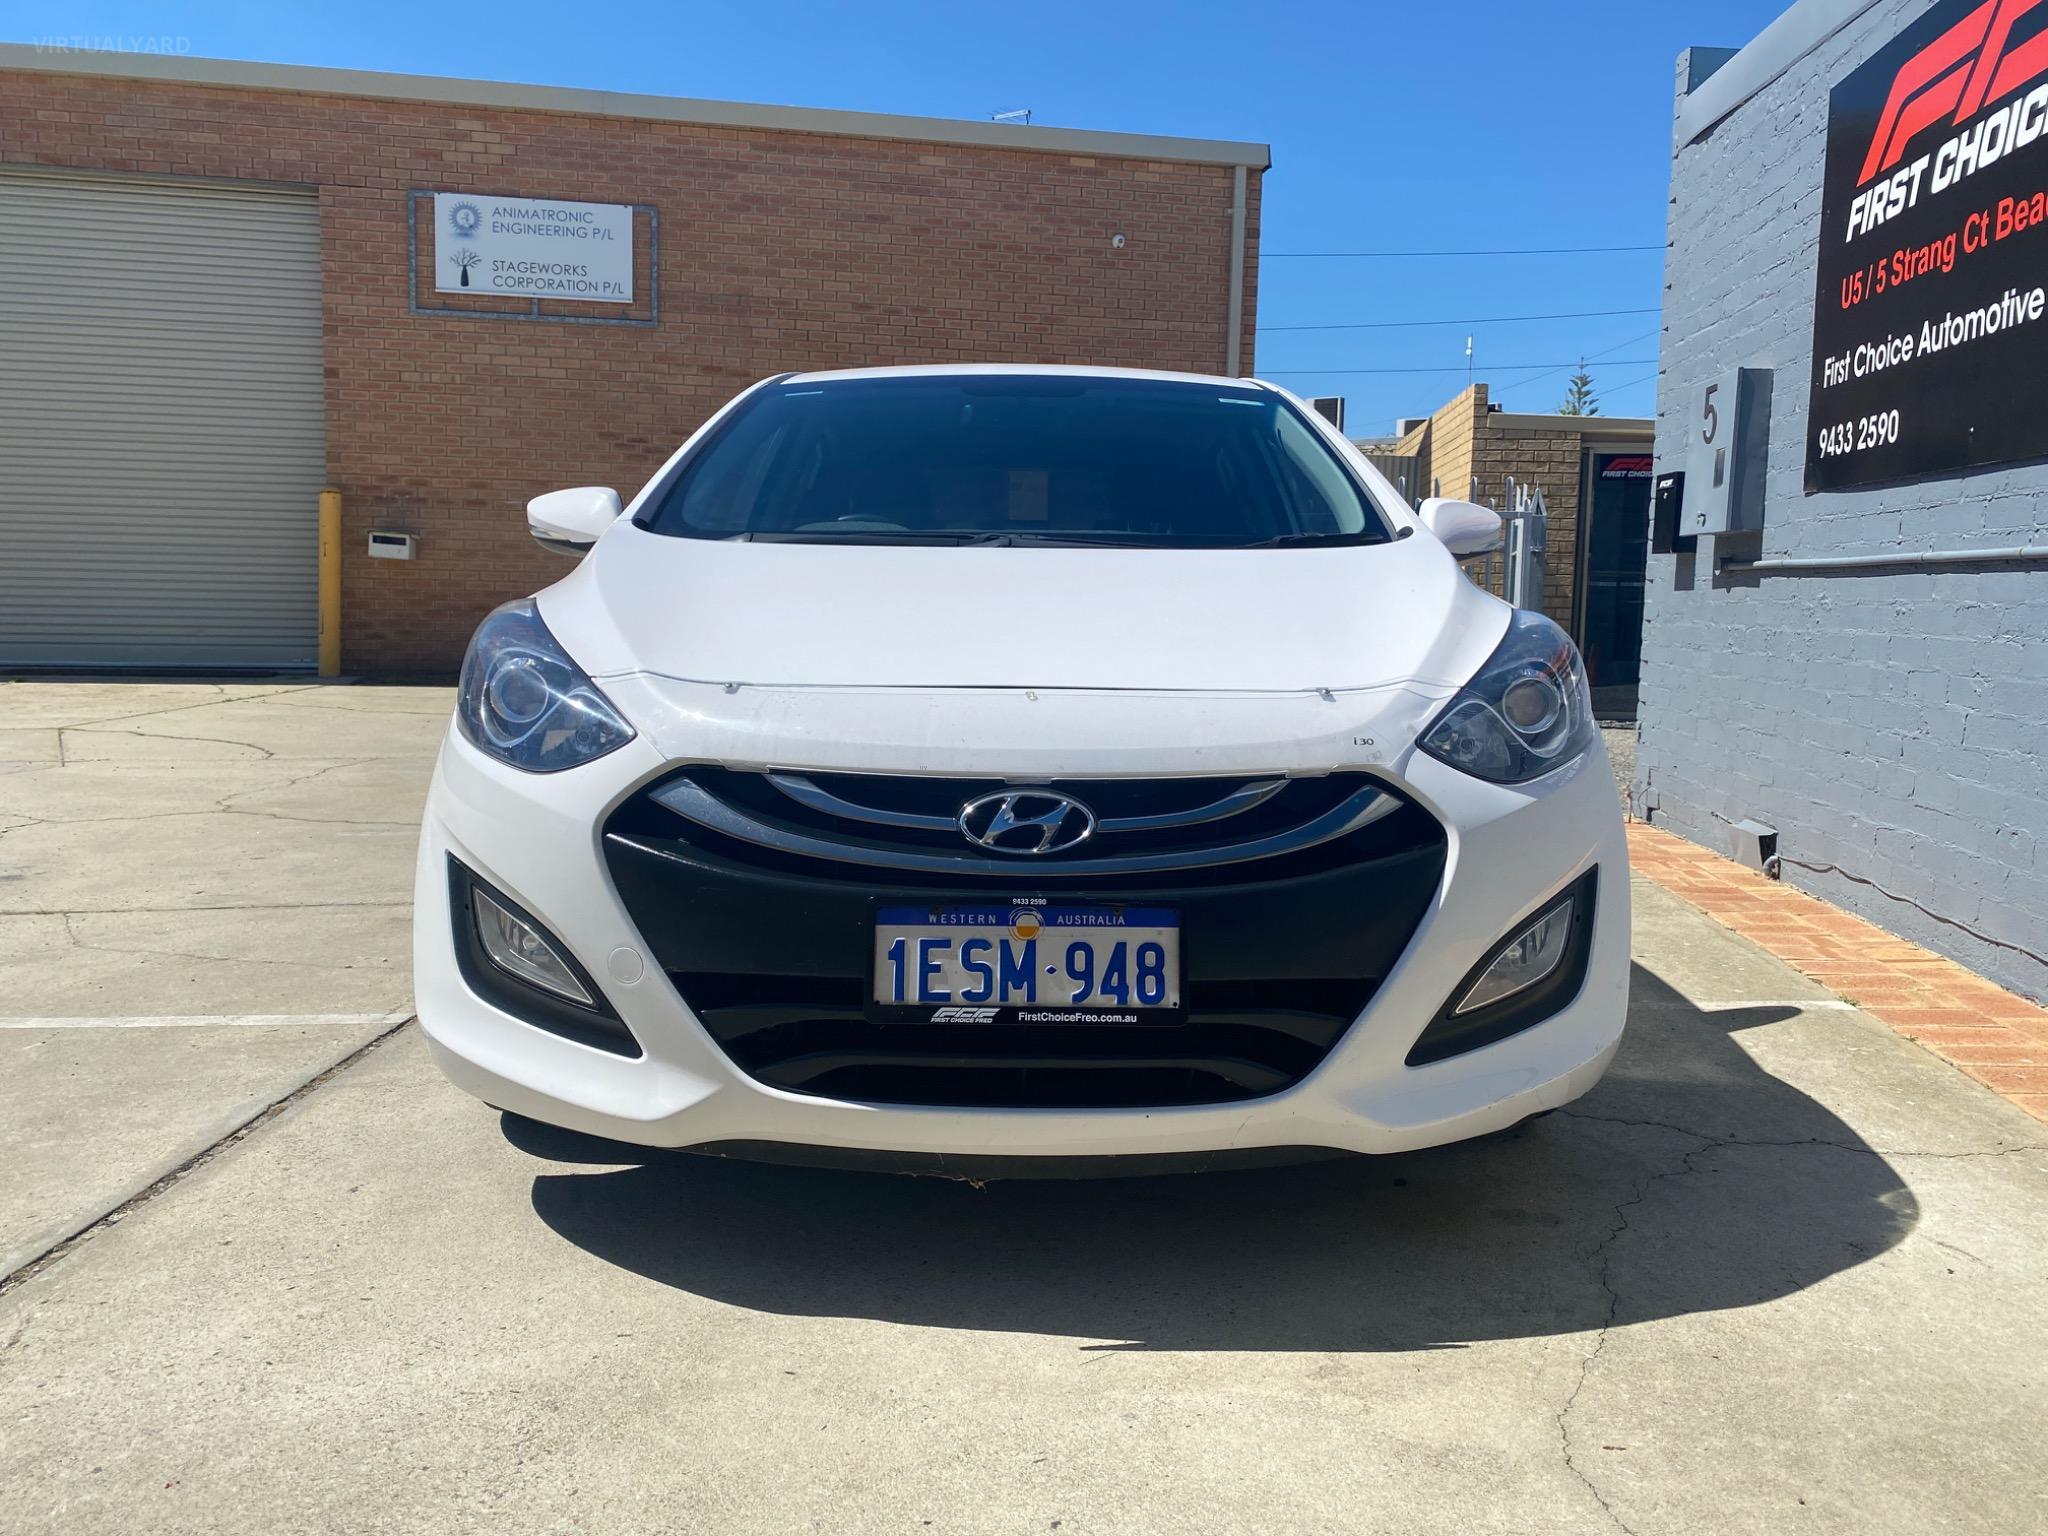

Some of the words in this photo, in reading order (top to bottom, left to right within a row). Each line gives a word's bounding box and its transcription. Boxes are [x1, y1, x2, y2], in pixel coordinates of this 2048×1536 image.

[1846, 153, 1930, 243] FIRST
[492, 206, 593, 224] ANIMATRONIC
[492, 221, 588, 239] ENGINEERING
[592, 227, 614, 241] P/L
[1841, 271, 1863, 309] U5
[1876, 258, 1888, 293] 5
[1891, 233, 1956, 286] Strang
[1963, 210, 1990, 253] Ct
[1995, 192, 2048, 241] Bea
[492, 260, 587, 277] STAGEWORKS
[493, 275, 598, 293] CORPORATION
[603, 281, 624, 295] P/L
[1823, 351, 1850, 389] First
[1853, 334, 1914, 378] Choice
[1917, 287, 2045, 357] Automotive
[1703, 384, 1718, 444] 5
[1819, 421, 1852, 459] 9433
[1857, 409, 1900, 450] 2590
[1602, 470, 1627, 478] FIRST
[928, 913, 997, 925] WESTERN
[1056, 914, 1126, 926] AUSTRALIA
[1018, 1011, 1138, 1023] FirstChoiceFreo.com.au
